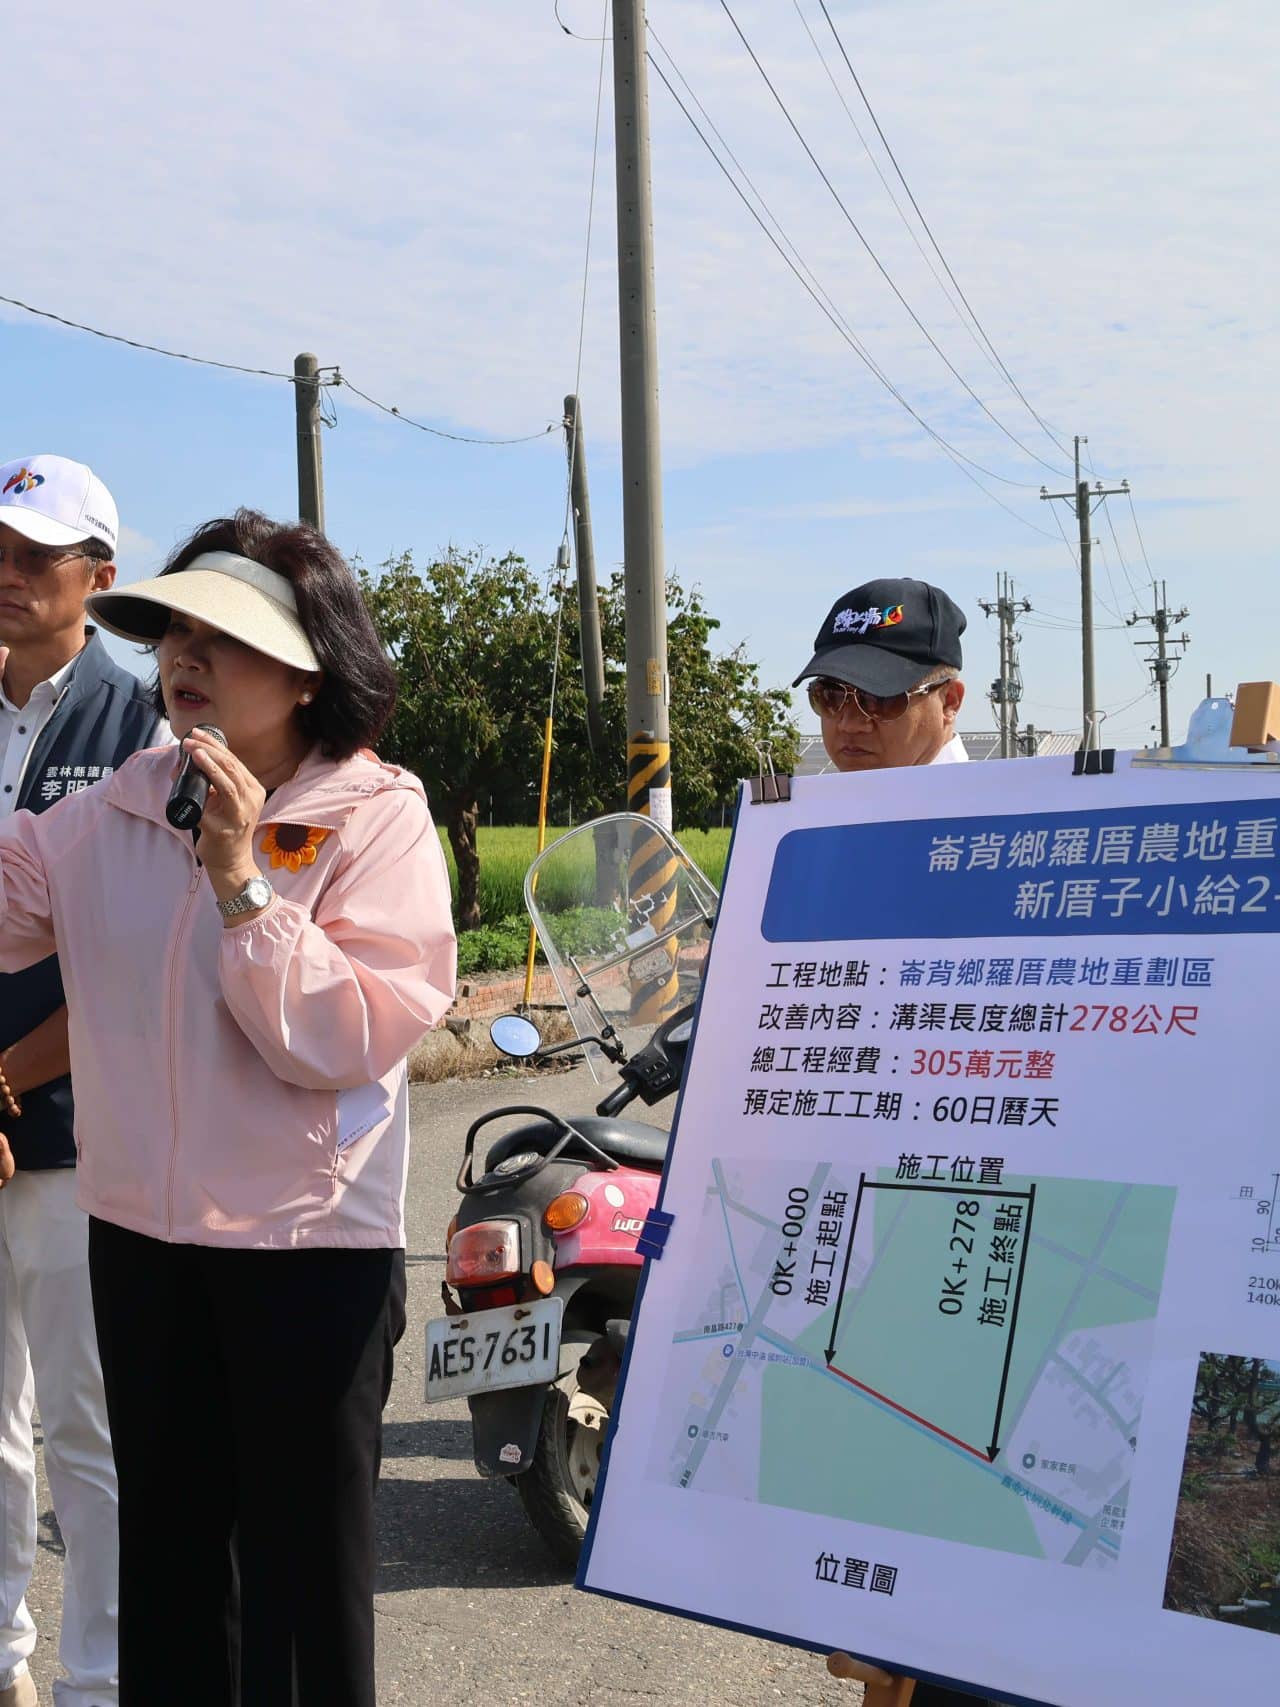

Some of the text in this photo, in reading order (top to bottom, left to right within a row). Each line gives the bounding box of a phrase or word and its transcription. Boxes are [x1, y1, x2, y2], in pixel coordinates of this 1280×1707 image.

[41, 780, 97, 800] 李明
[46, 766, 114, 778] 雲林縣議員
[928, 817, 1278, 873] 崙背鄉羅厝農地重
[895, 1153, 1005, 1185] 施工位置
[1256, 1200, 1271, 1215] 90
[772, 1187, 809, 1296] 0K+000
[804, 1190, 848, 1306] 施工起點
[938, 1200, 980, 1315] 0K+278
[1251, 1237, 1265, 1253] 10
[977, 1203, 1023, 1327] 施工終點
[815, 1552, 898, 1596] 位置圖
